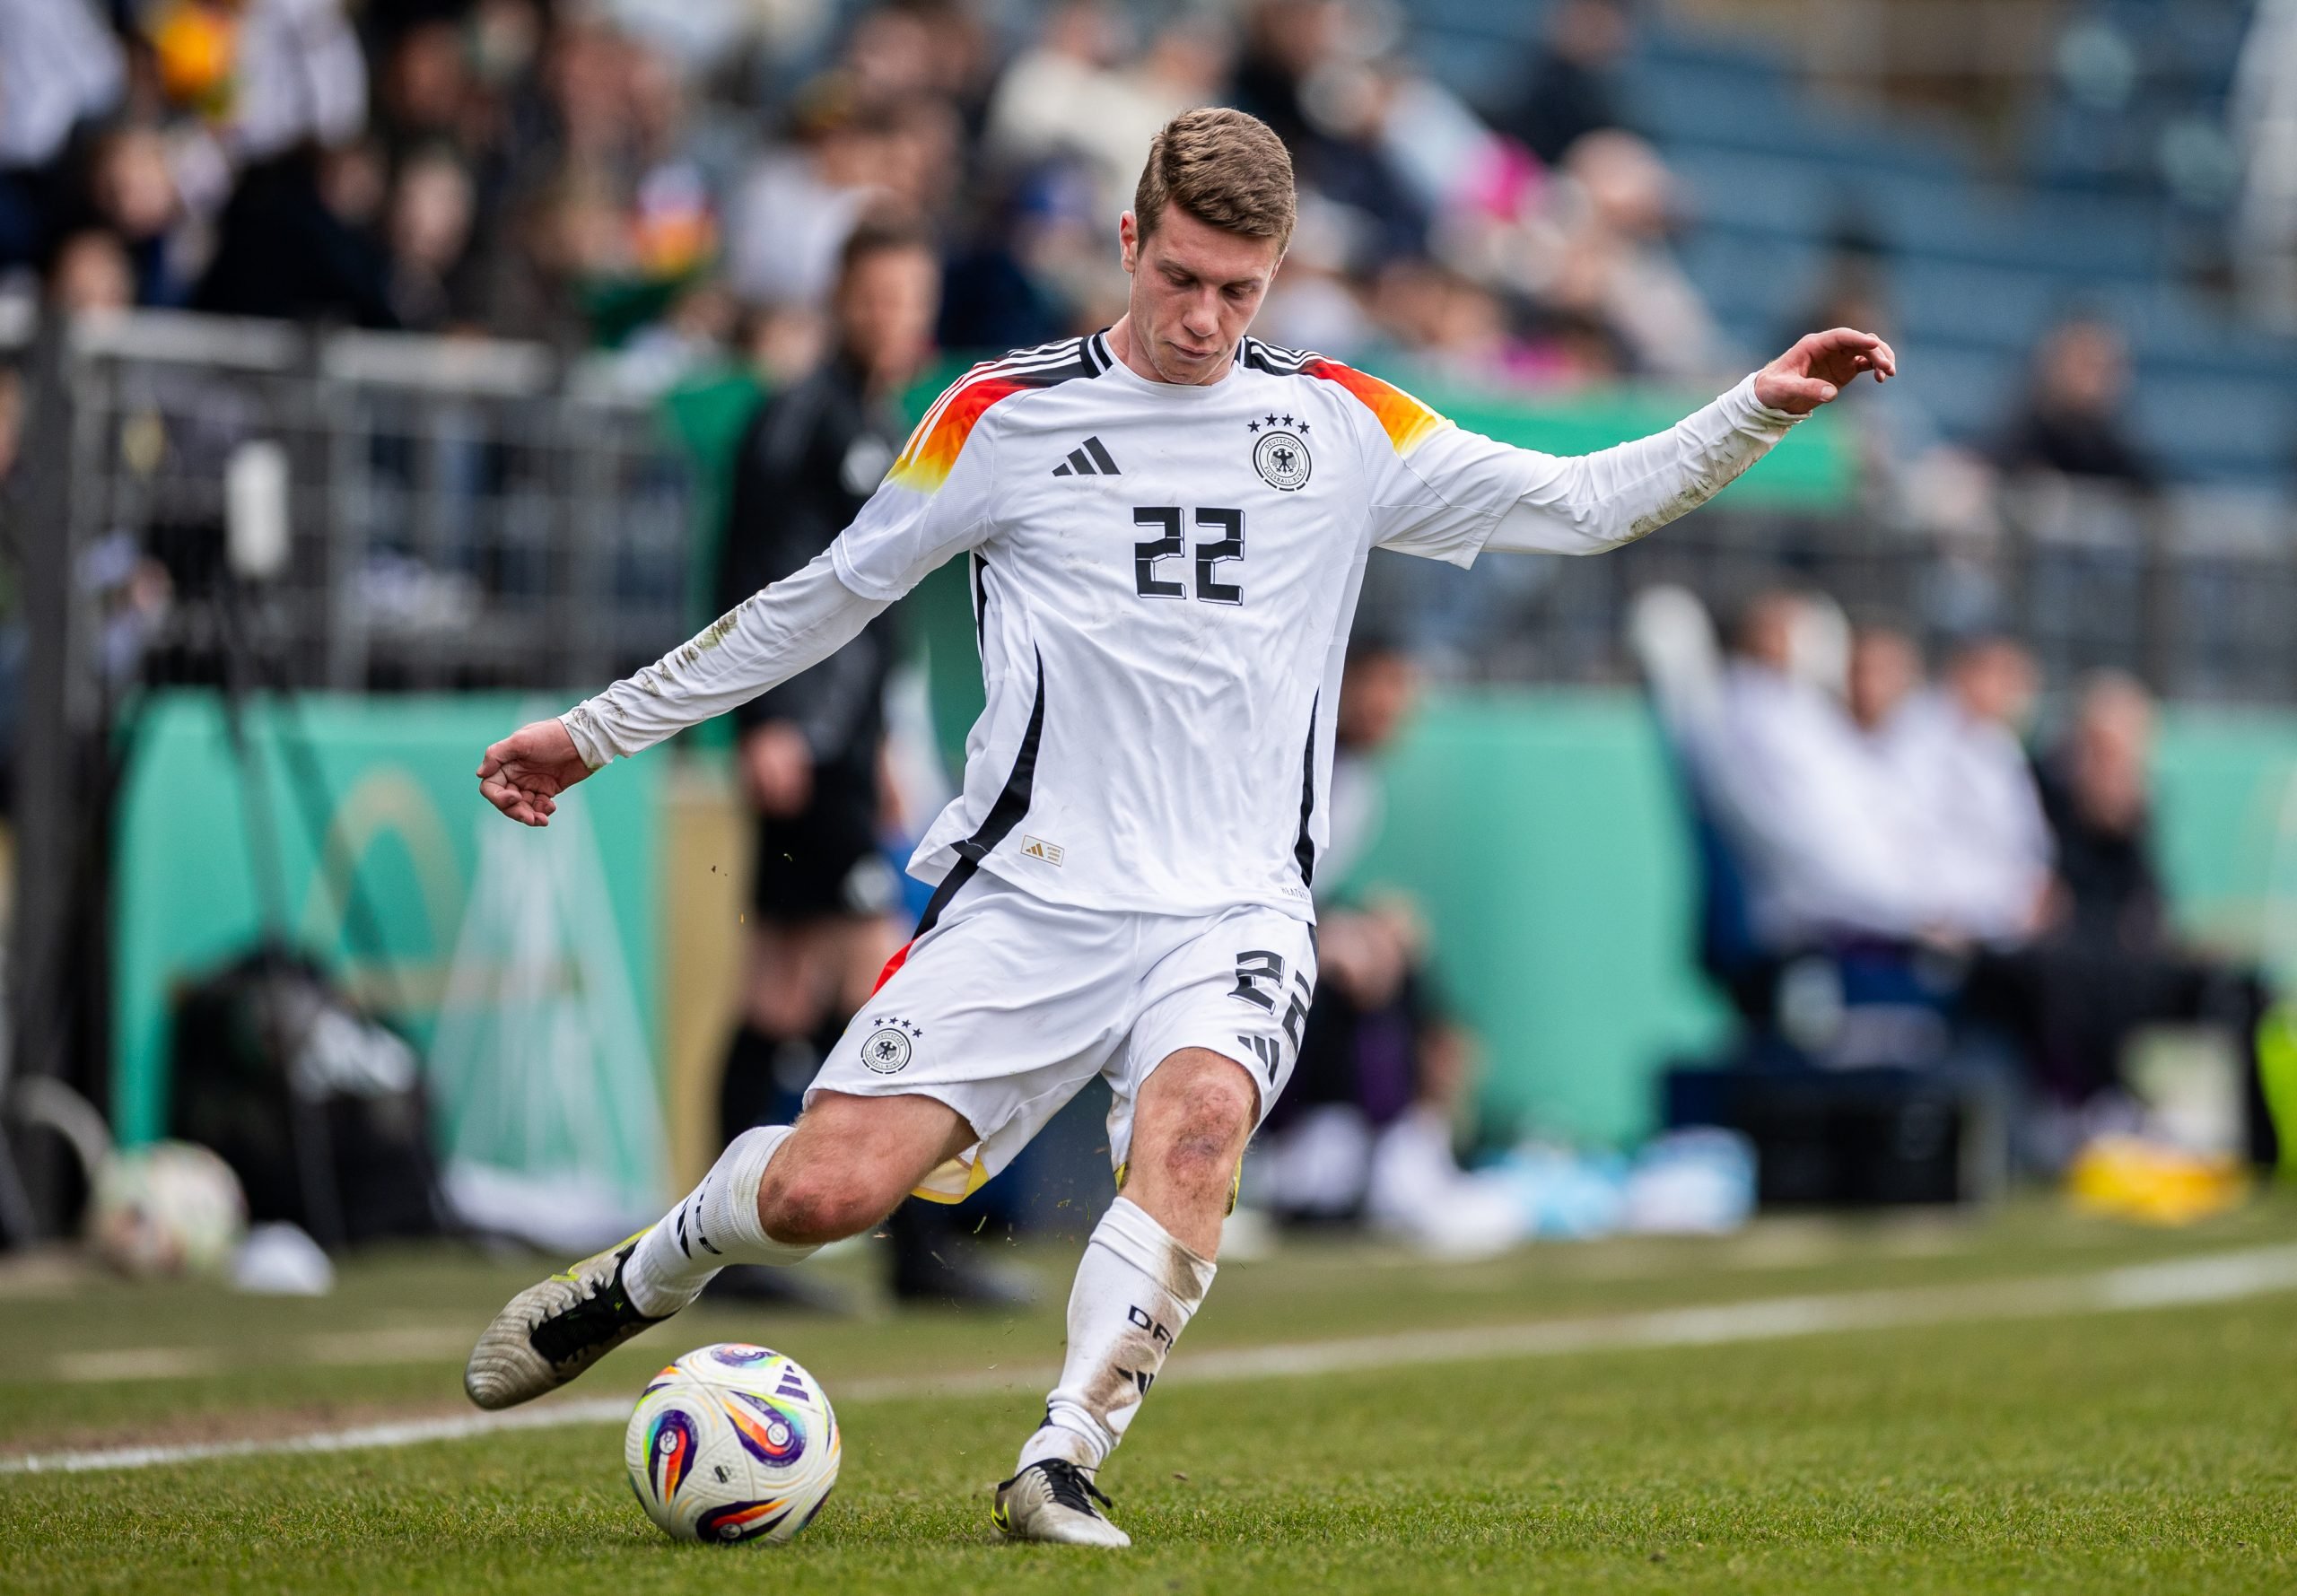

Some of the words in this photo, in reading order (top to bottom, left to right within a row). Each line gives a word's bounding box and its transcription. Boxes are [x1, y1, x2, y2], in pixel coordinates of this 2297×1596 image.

[1265, 439, 1298, 450] DEUTSCHER
[1264, 467, 1304, 484] FUSSBALL-BUND
[1133, 507, 1245, 606] 22
